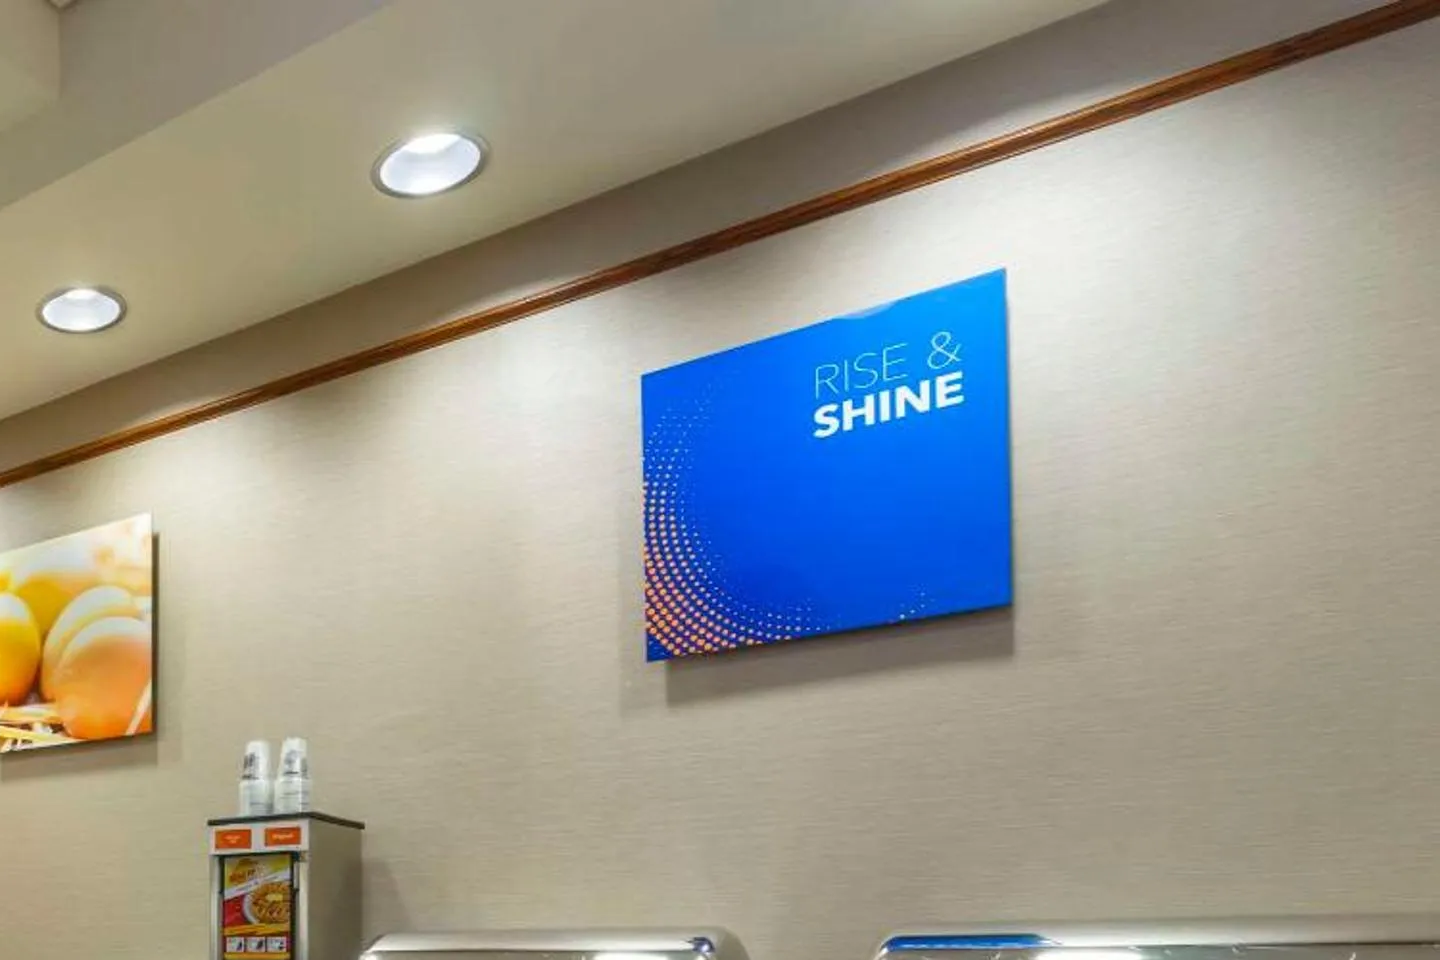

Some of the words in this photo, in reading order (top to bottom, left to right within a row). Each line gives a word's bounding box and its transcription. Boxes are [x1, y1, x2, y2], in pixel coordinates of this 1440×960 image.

[815, 343, 908, 399] RISE
[927, 331, 962, 370] &
[813, 370, 965, 438] SHINE
